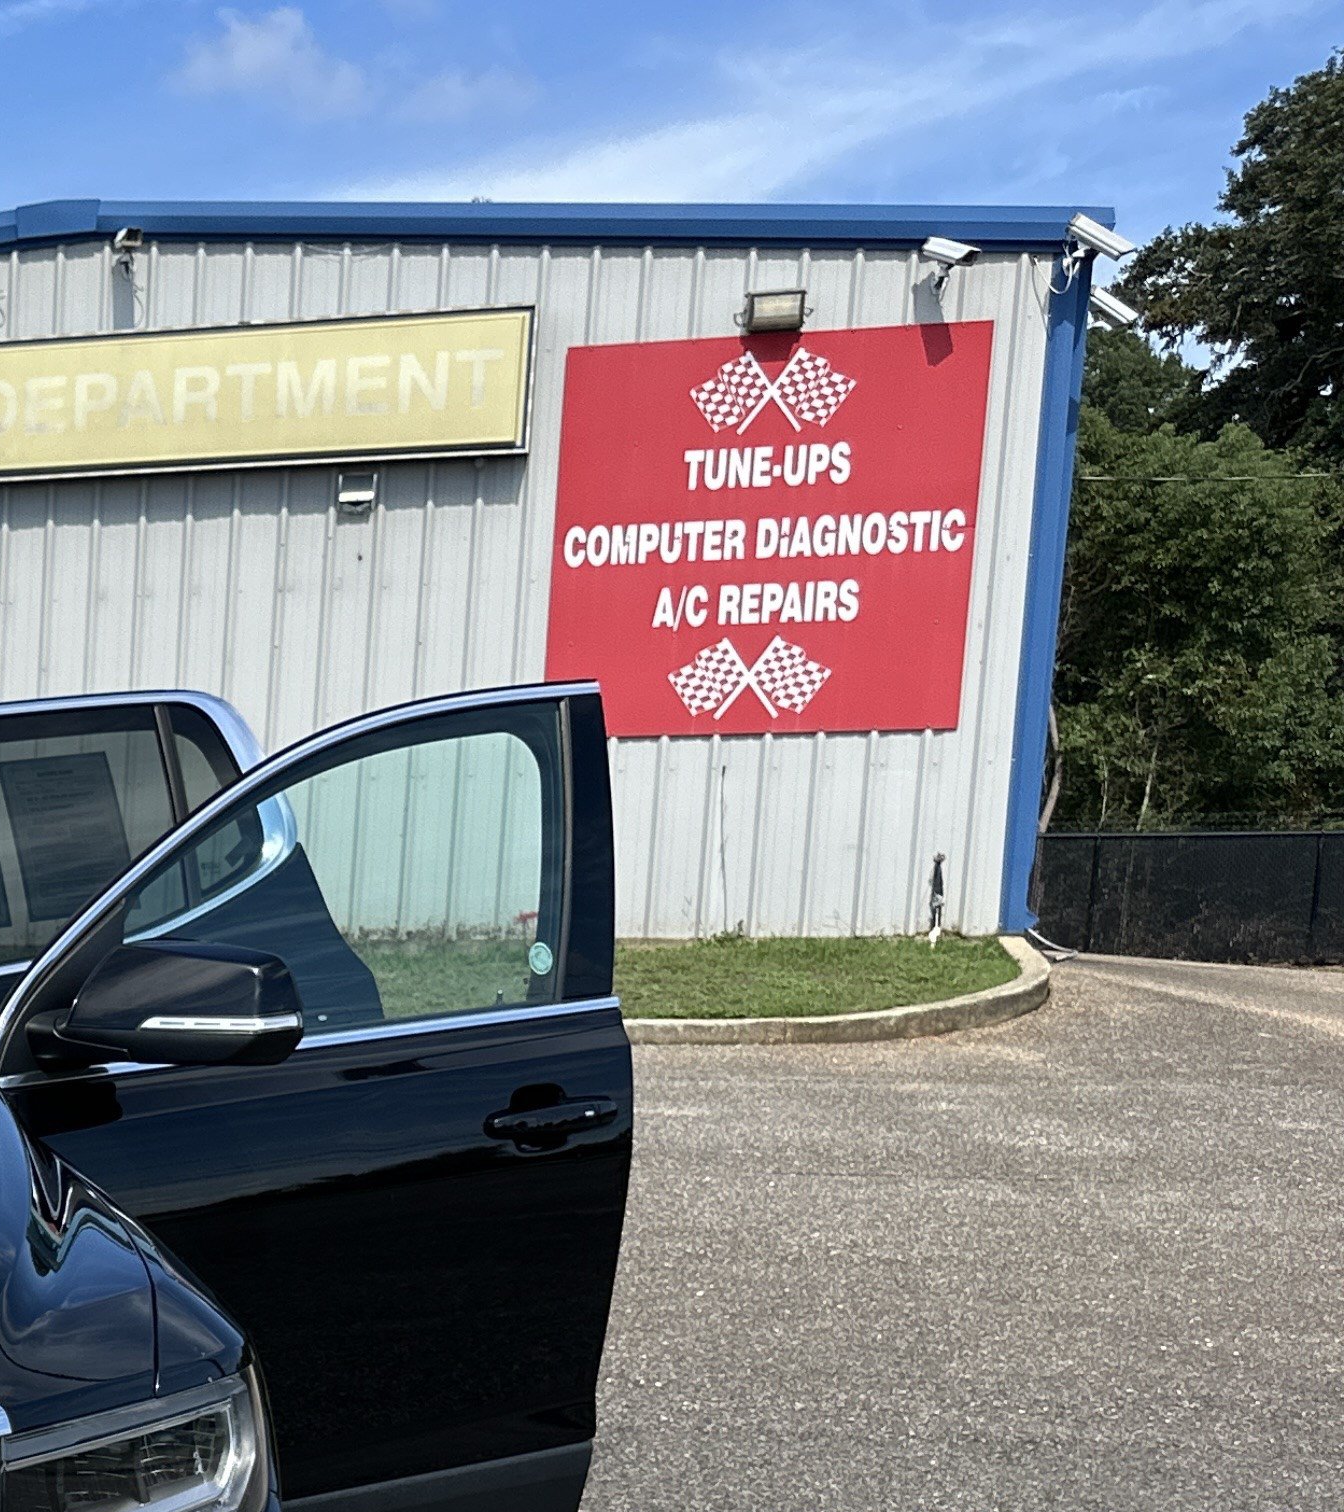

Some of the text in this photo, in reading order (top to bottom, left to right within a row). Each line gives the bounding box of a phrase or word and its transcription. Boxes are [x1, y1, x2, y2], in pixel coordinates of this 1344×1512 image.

[684, 443, 852, 490] TUNE-UPS
[564, 509, 966, 568] COMPUTER DIAGNOSTIC
[652, 579, 860, 632] A/C REPAIRS
